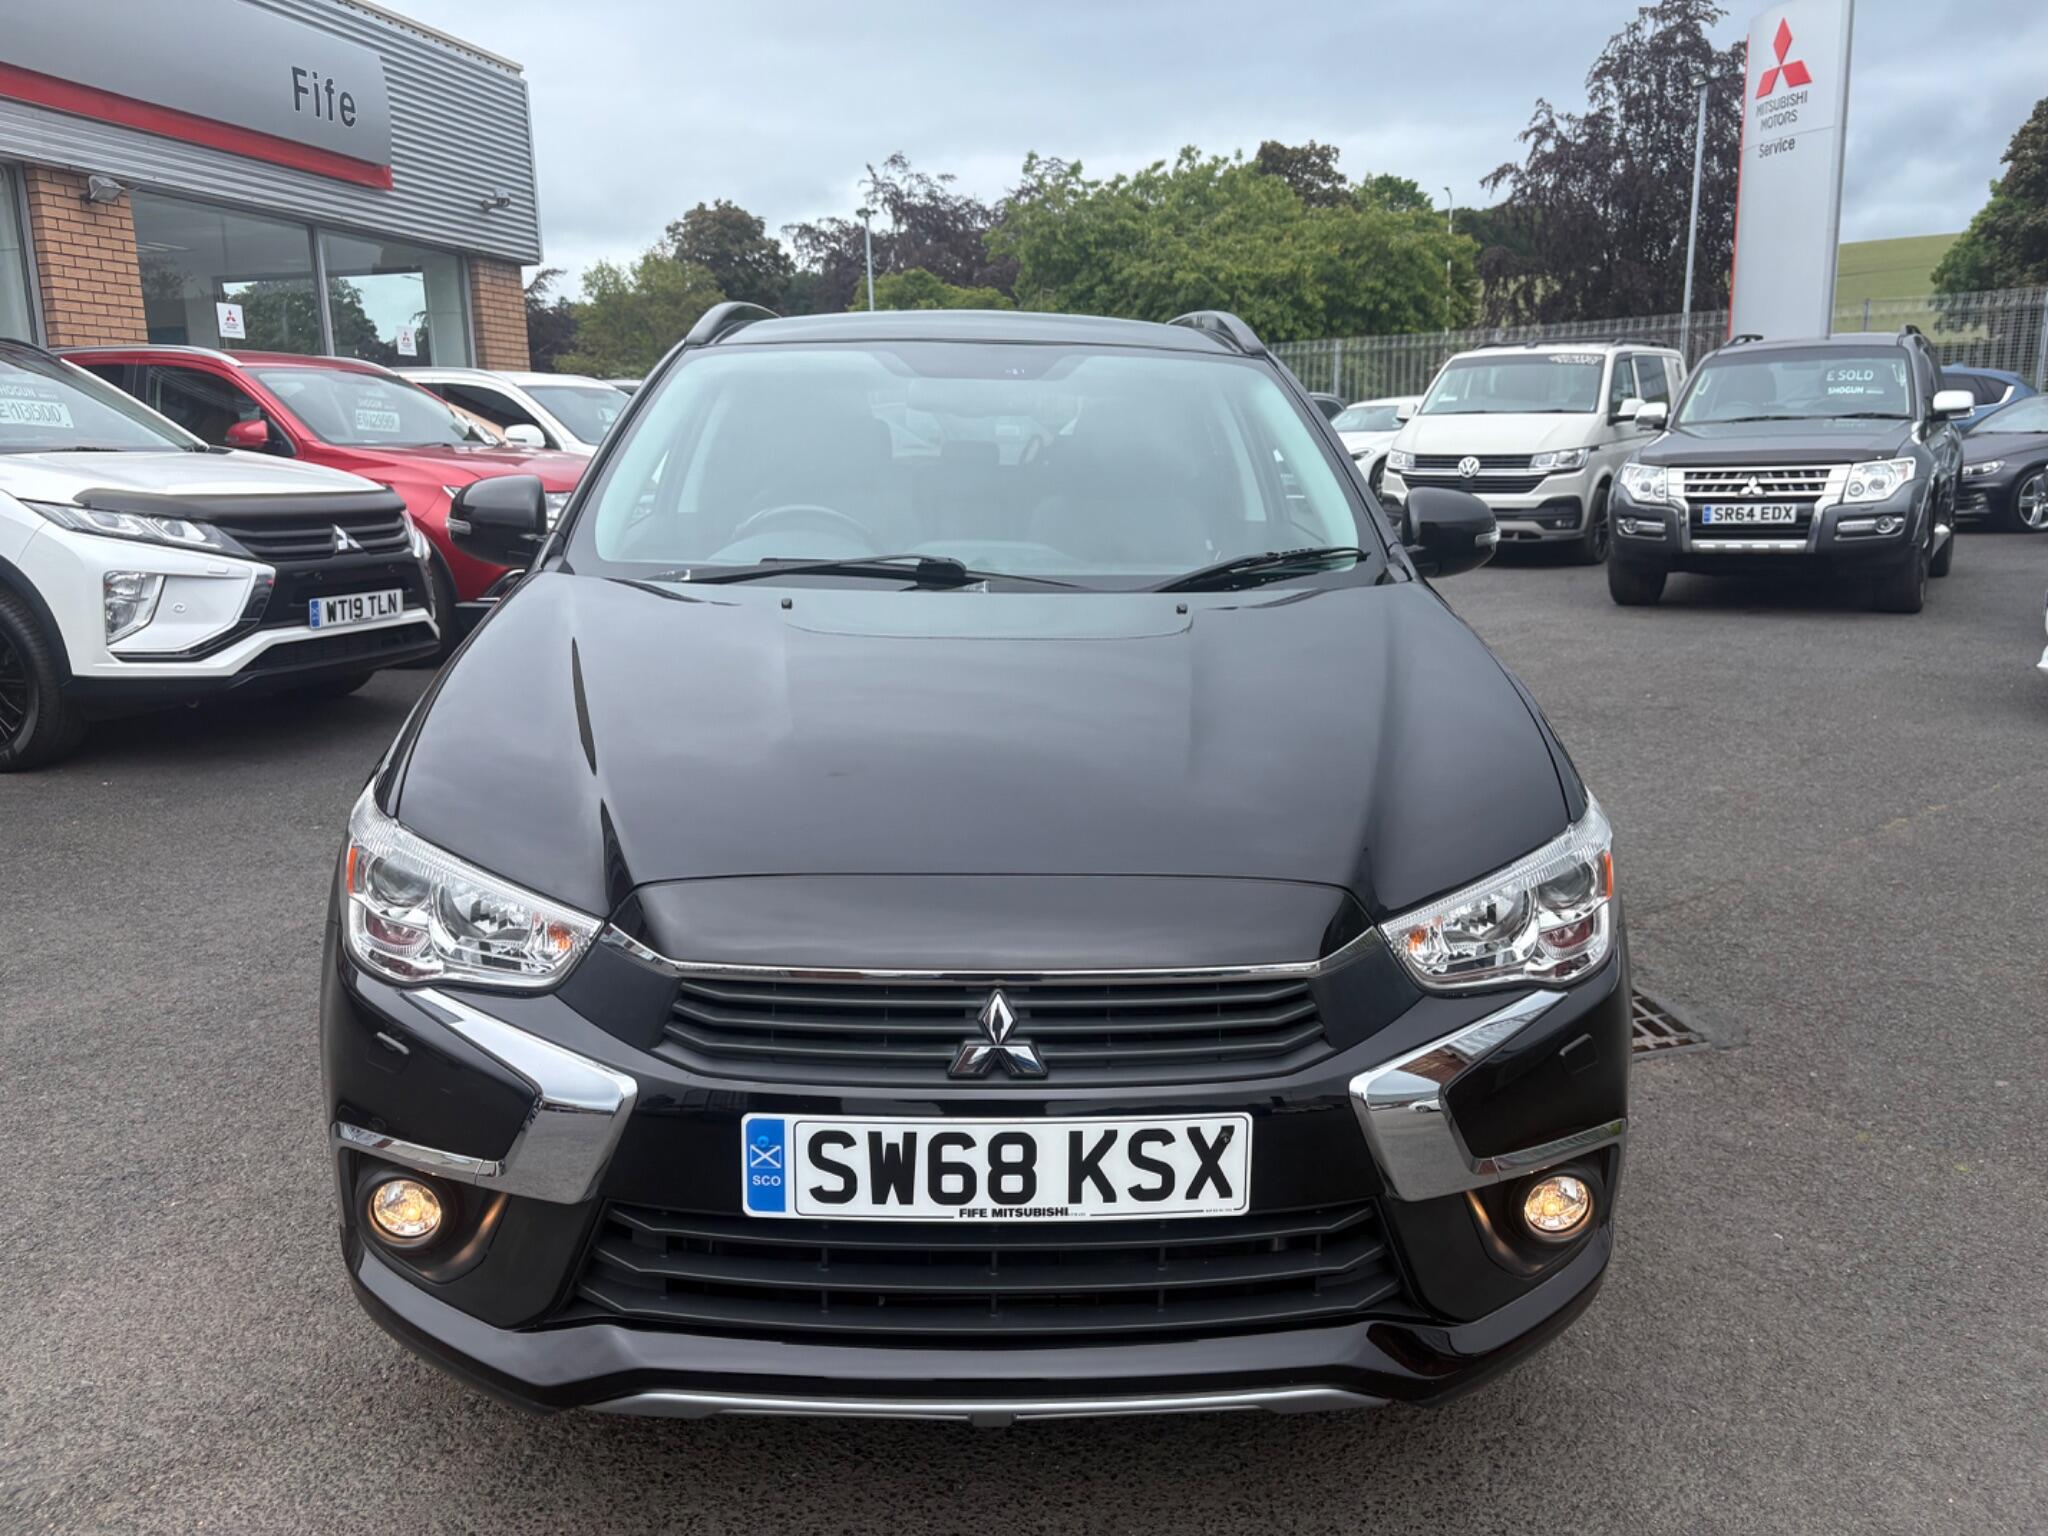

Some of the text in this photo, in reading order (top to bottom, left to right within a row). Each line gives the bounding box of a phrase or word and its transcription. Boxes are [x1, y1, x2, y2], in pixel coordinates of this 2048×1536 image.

[291, 65, 357, 127] Fife
[1756, 90, 1808, 117] MITSUBISHI
[1760, 109, 1798, 131] MOTORS
[1759, 138, 1795, 158] Service
[1837, 369, 1874, 381] SOLD
[1827, 386, 1864, 395] SHOGUN
[1714, 506, 1793, 521] SR64 EDX
[326, 592, 397, 622] WT19 TLN
[807, 1125, 1235, 1206] SW68 KSX
[752, 1175, 781, 1187] SCO
[959, 1208, 988, 1218] FIFE
[991, 1207, 1069, 1218] MITSUBISHI
